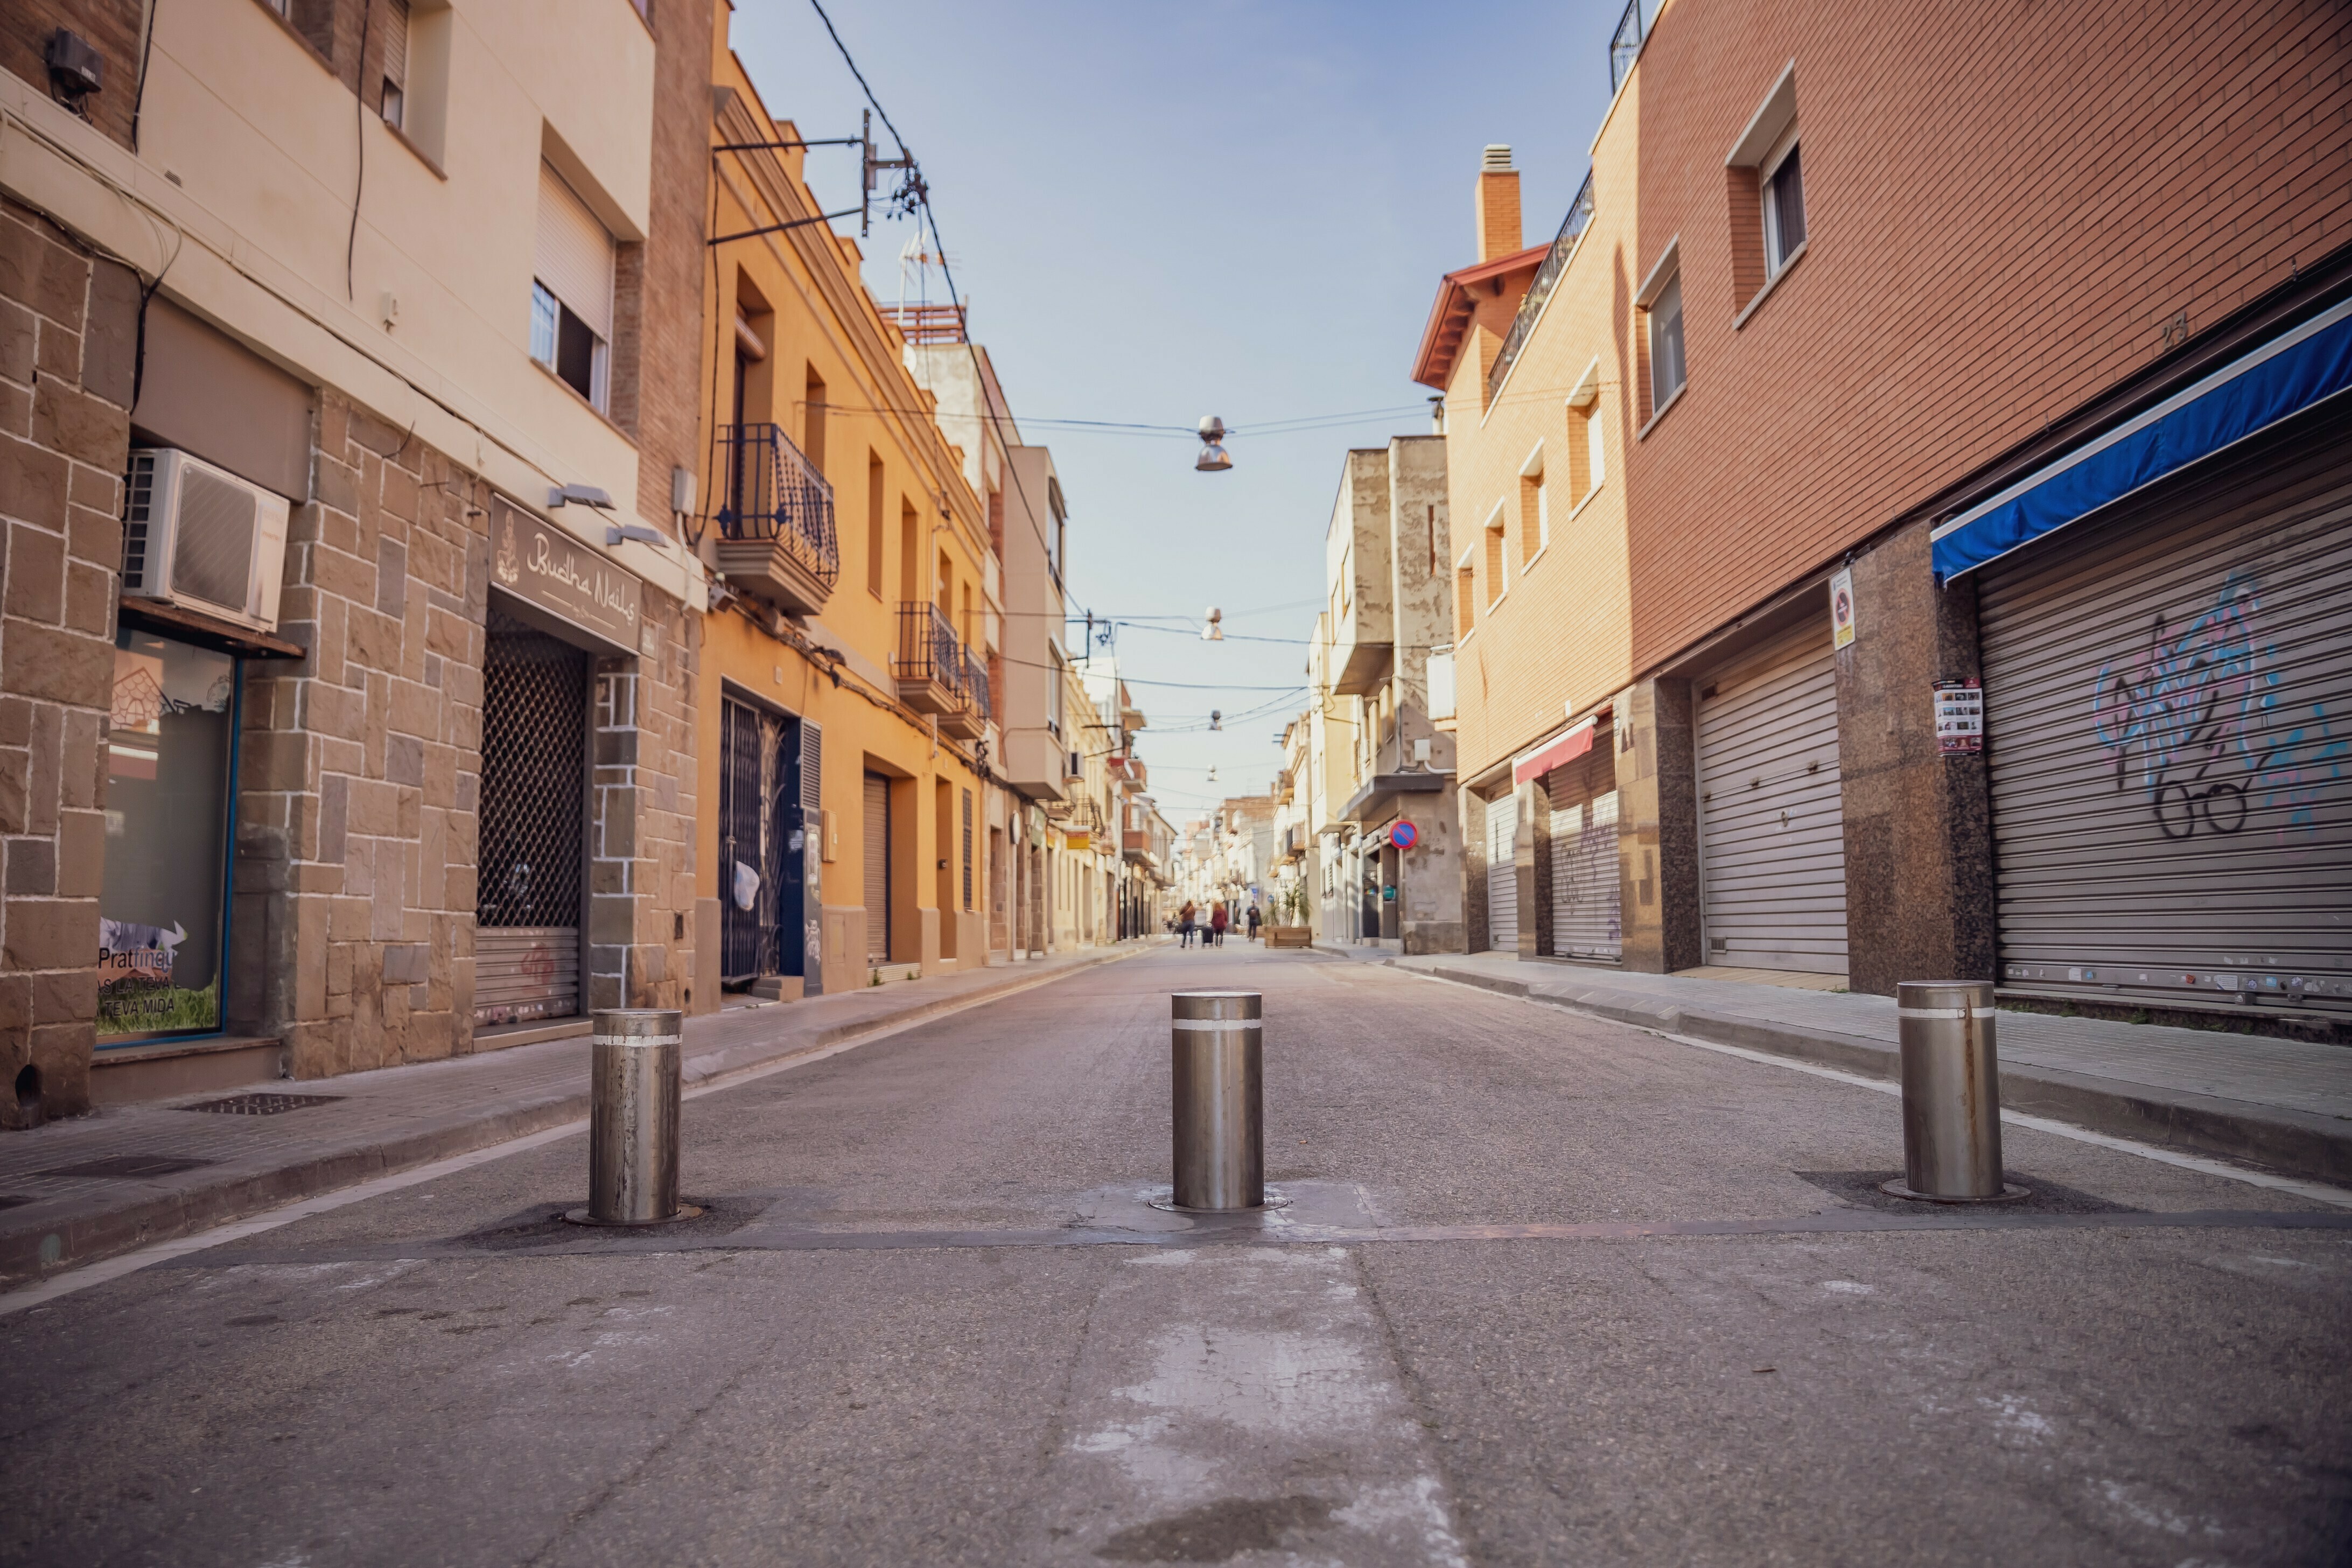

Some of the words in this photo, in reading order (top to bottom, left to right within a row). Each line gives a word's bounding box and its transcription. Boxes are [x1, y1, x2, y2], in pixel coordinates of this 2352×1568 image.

[527, 532, 592, 596] Budha
[594, 569, 634, 624] Nails
[139, 976, 170, 991] TEVA
[106, 1000, 138, 1017] TEVA
[143, 998, 175, 1013] MIDA
